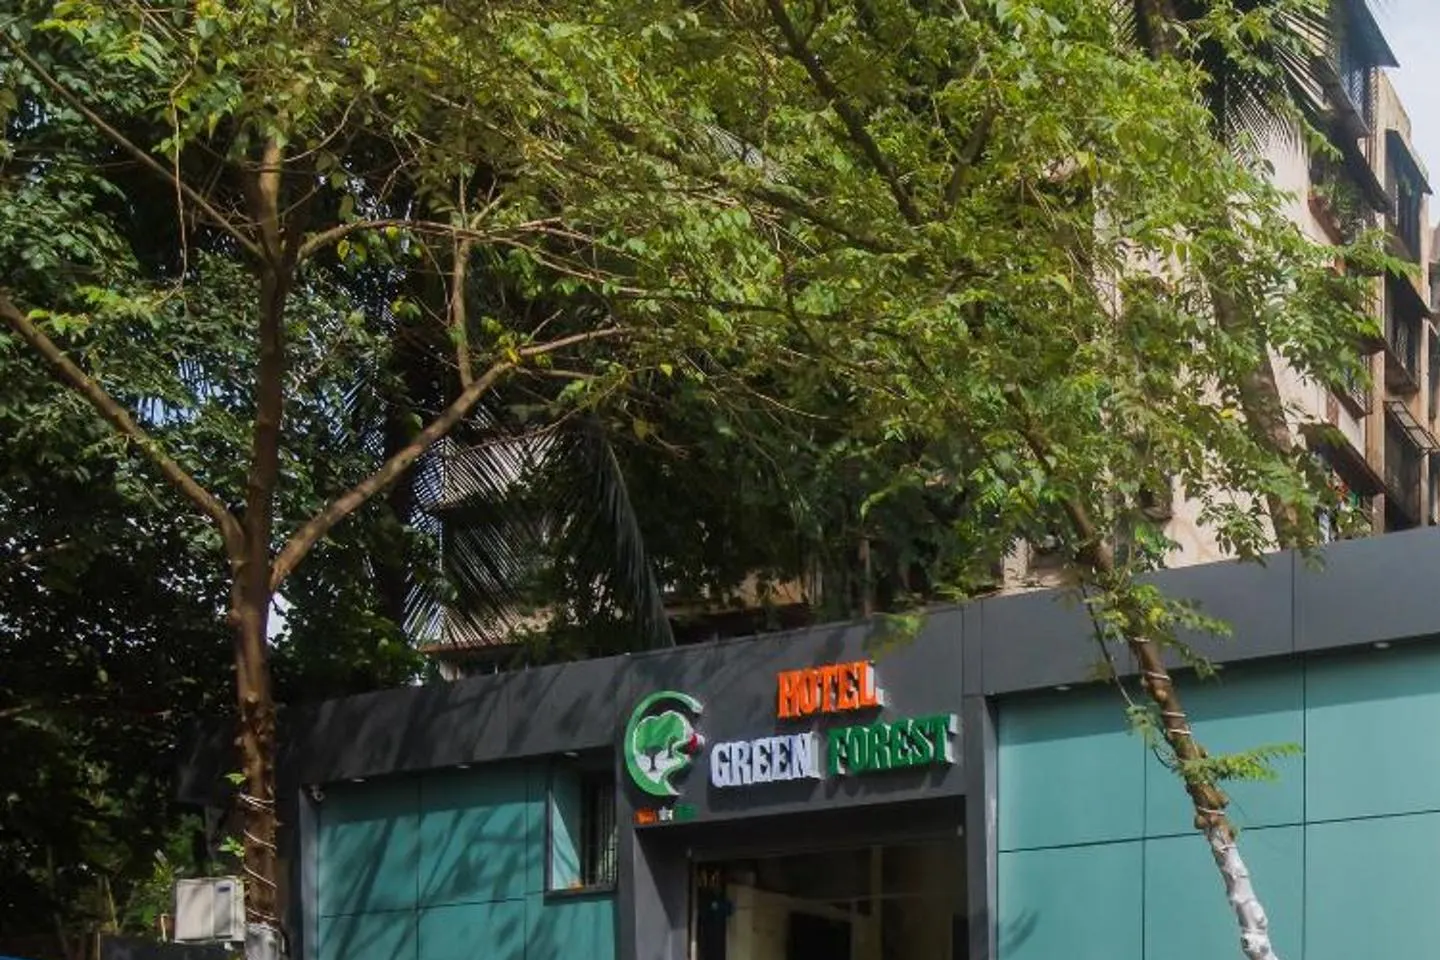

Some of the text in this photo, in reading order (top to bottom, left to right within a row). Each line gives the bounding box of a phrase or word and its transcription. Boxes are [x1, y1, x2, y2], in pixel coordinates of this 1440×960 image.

[777, 661, 886, 718] HOTEL
[711, 713, 958, 787] GREEN FOREST
